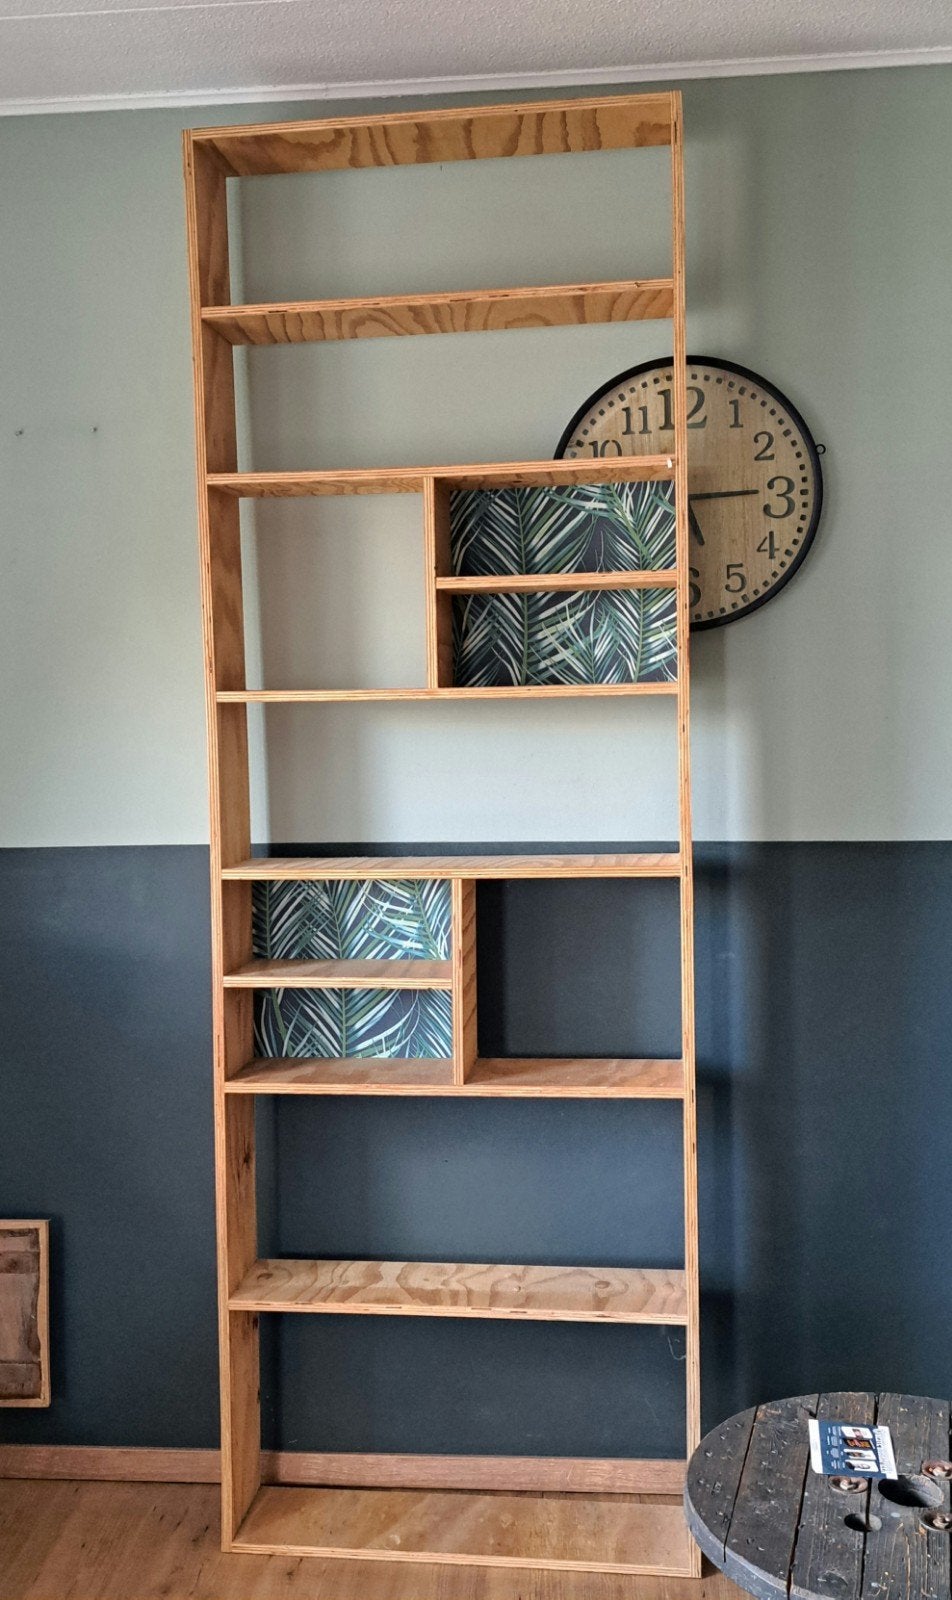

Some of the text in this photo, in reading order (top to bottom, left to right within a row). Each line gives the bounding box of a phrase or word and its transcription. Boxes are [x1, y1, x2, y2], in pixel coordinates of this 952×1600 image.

[621, 405, 652, 435] 11
[657, 386, 708, 430] 12
[728, 399, 744, 428] 1
[753, 431, 775, 461] 2
[762, 476, 795, 519] 3
[756, 530, 780, 560] 4
[724, 562, 748, 593] 5
